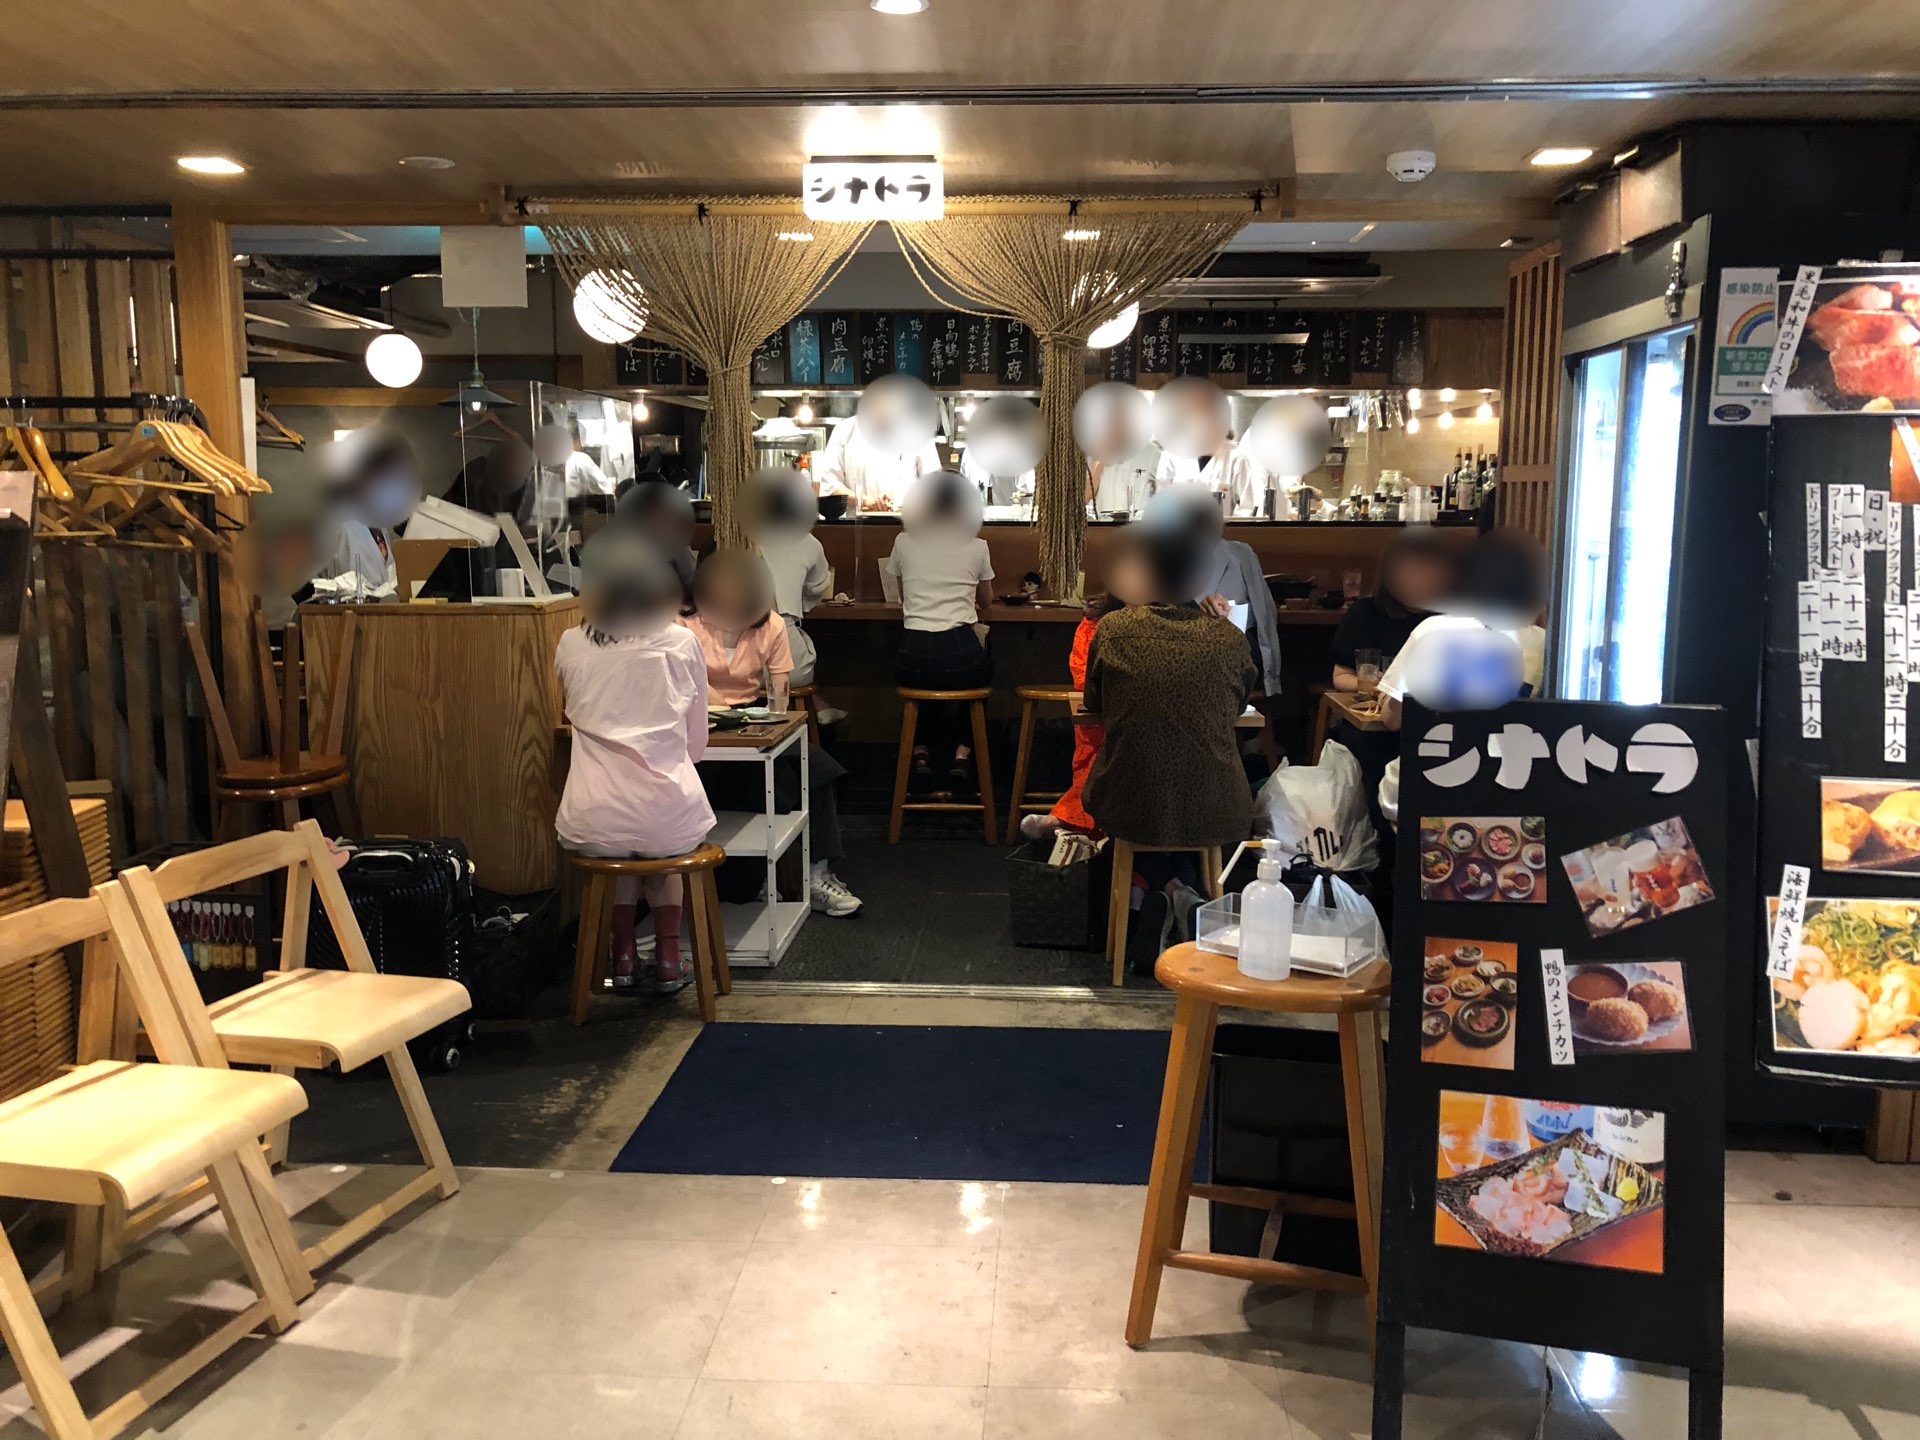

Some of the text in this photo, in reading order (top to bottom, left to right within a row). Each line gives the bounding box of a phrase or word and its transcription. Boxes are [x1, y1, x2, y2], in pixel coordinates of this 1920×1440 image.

[811, 175, 931, 204] シナトラ
[795, 319, 816, 383] 緑茶ハイ
[829, 317, 849, 374] 肉豆腐
[929, 337, 945, 383] 唐揚げ
[1003, 318, 1023, 382] 肉豆腐
[1417, 723, 1699, 793] シナトラ
[1544, 960, 1568, 1062] 鴨のメンチカツ
